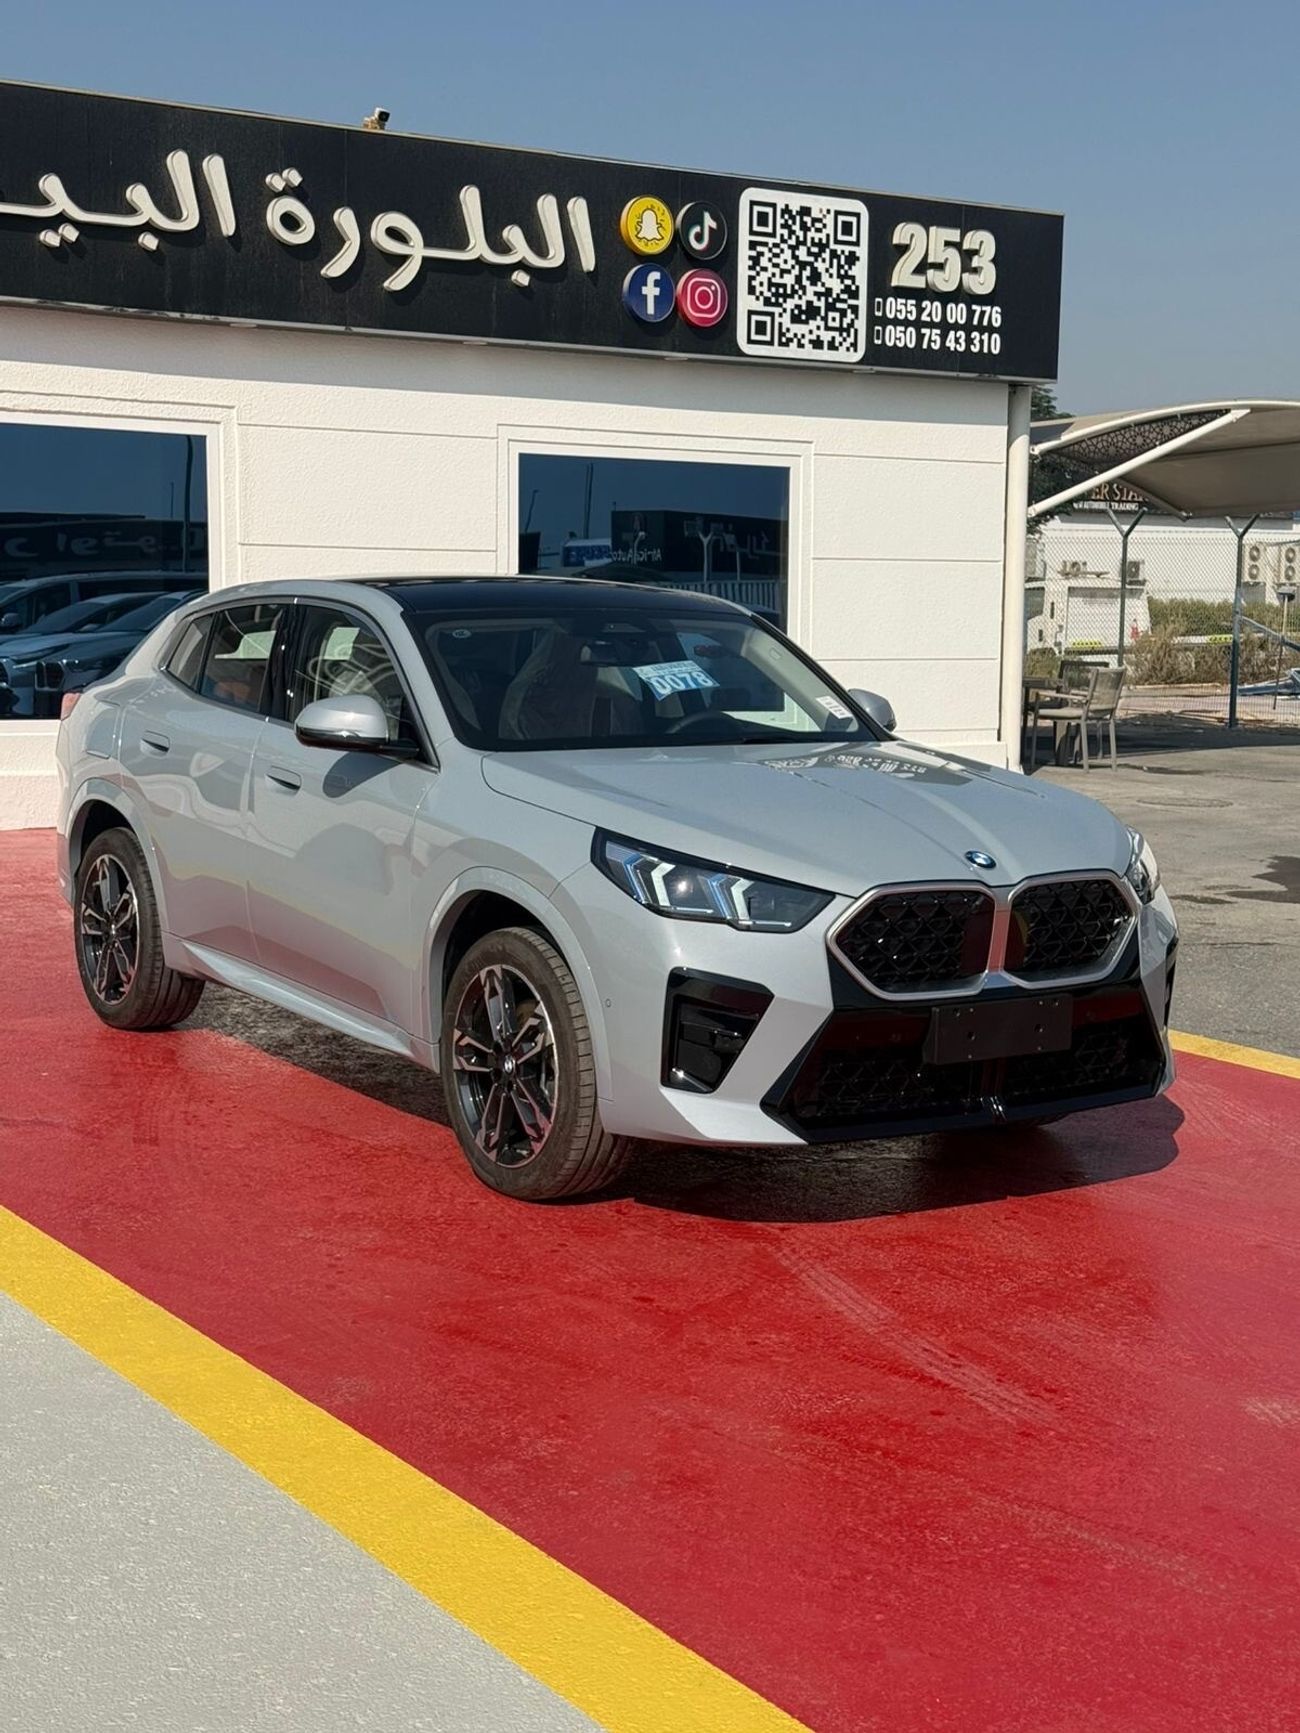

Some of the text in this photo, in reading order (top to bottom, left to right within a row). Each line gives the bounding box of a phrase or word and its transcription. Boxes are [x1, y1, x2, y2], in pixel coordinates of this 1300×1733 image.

[0, 149, 596, 292] البلورة البي
[891, 222, 996, 294] 253
[885, 297, 1002, 328] 055 20 00 776
[884, 324, 1001, 355] 050 75 43 310
[1111, 502, 1139, 511] TRADING
[650, 671, 713, 694] 0078
